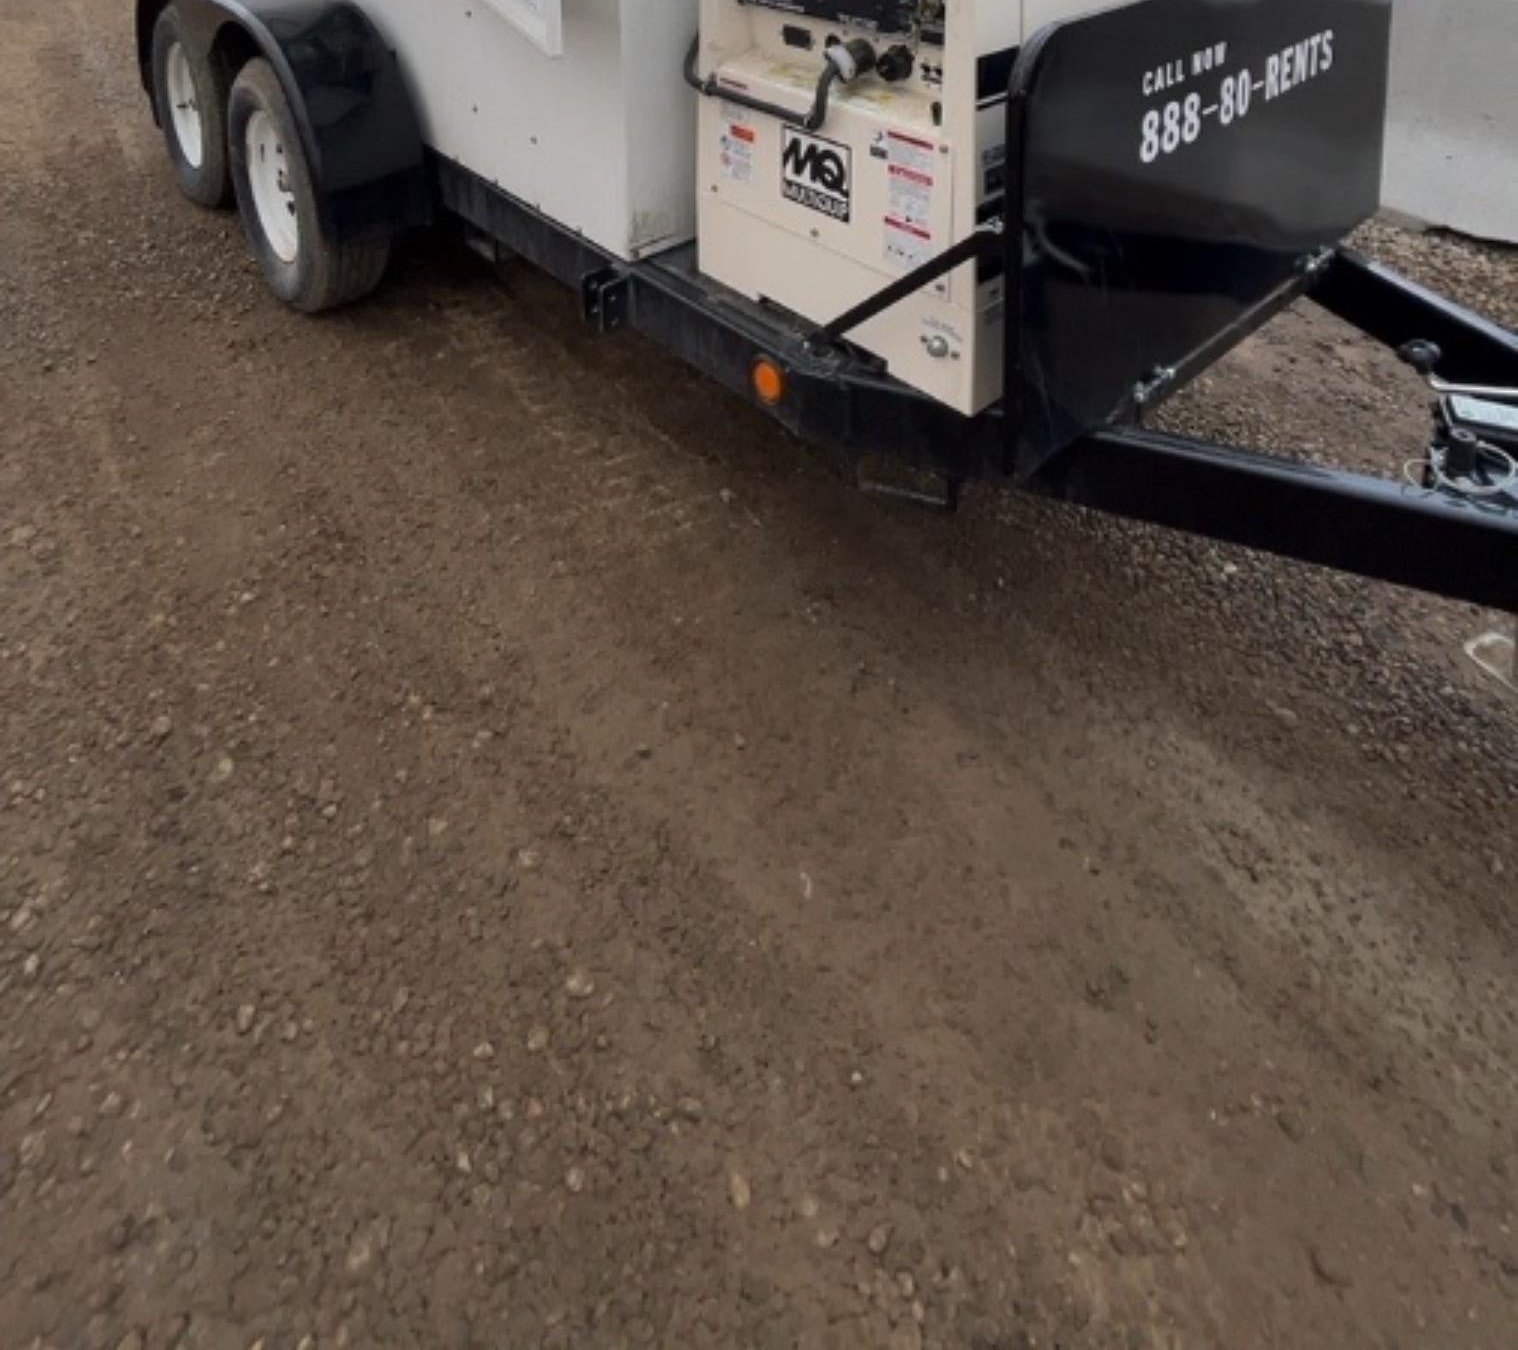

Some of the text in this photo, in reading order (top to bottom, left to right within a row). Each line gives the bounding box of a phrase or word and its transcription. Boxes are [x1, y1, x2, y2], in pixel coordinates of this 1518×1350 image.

[1139, 29, 1334, 163] 888-80-RENTS
[1142, 41, 1227, 97] CALL NOW
[783, 137, 848, 197] MQ
